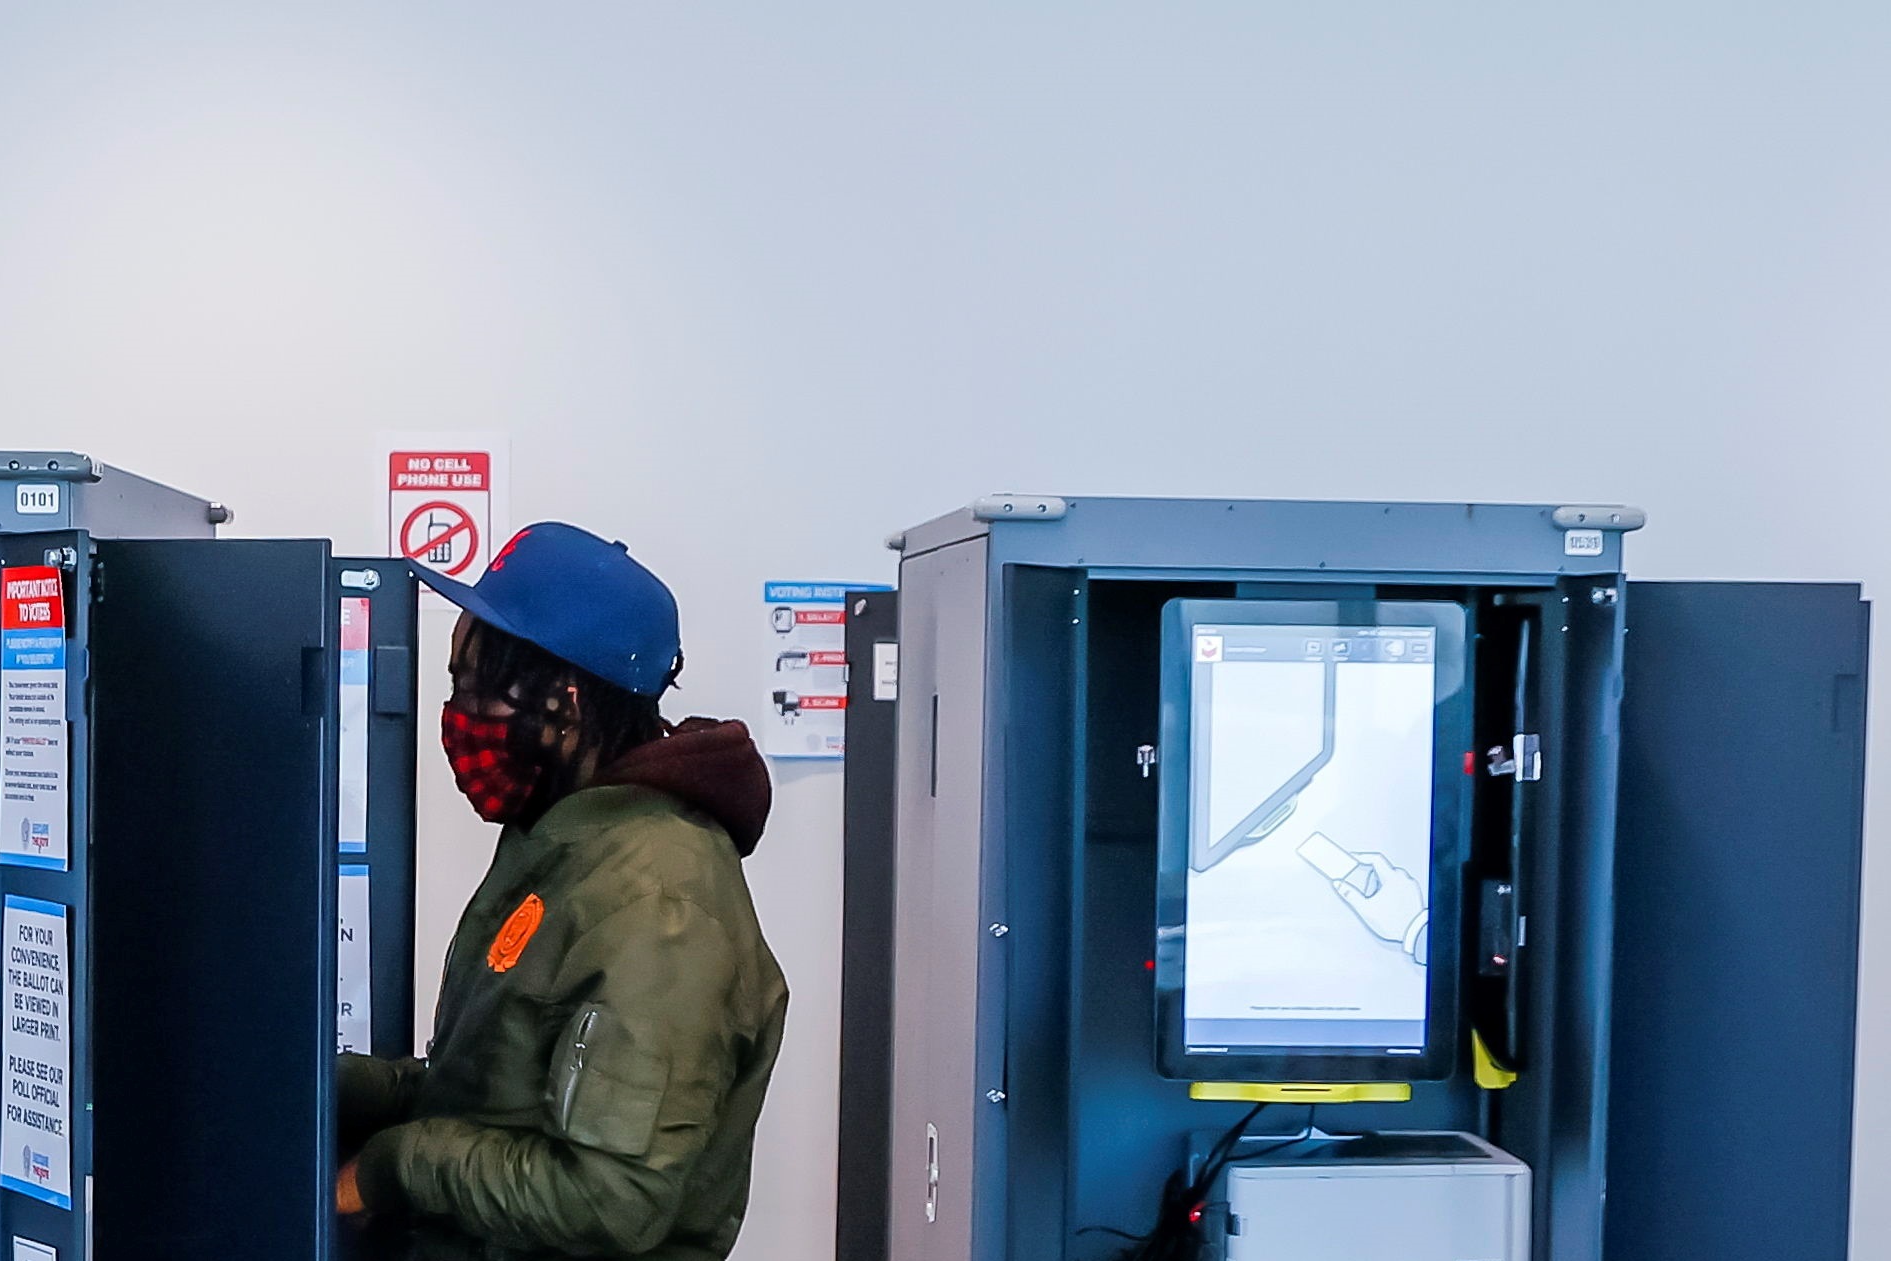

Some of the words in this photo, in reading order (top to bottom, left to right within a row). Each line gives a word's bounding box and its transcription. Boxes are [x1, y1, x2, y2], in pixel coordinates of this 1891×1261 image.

[408, 458, 430, 471] NO
[433, 458, 471, 471] CELL
[397, 473, 448, 487] PHONE
[451, 473, 482, 487] USE
[20, 492, 54, 506] 0101
[769, 586, 812, 598] VOTING
[19, 925, 33, 942] FOR
[34, 927, 53, 946] YOUR
[8, 968, 22, 987] THE
[23, 972, 48, 992] BALLOT
[50, 978, 64, 996] CAN
[14, 992, 24, 1010] BE
[25, 996, 50, 1016] VIEWED
[52, 1000, 58, 1018] IN
[12, 1016, 39, 1036] LARGER
[9, 1055, 34, 1078] PLEASE
[36, 1062, 48, 1081] SEE
[49, 1066, 64, 1085] OUR
[12, 1078, 30, 1099] POLL
[32, 1084, 60, 1108] OFFICIAL
[7, 1104, 22, 1122] FOR
